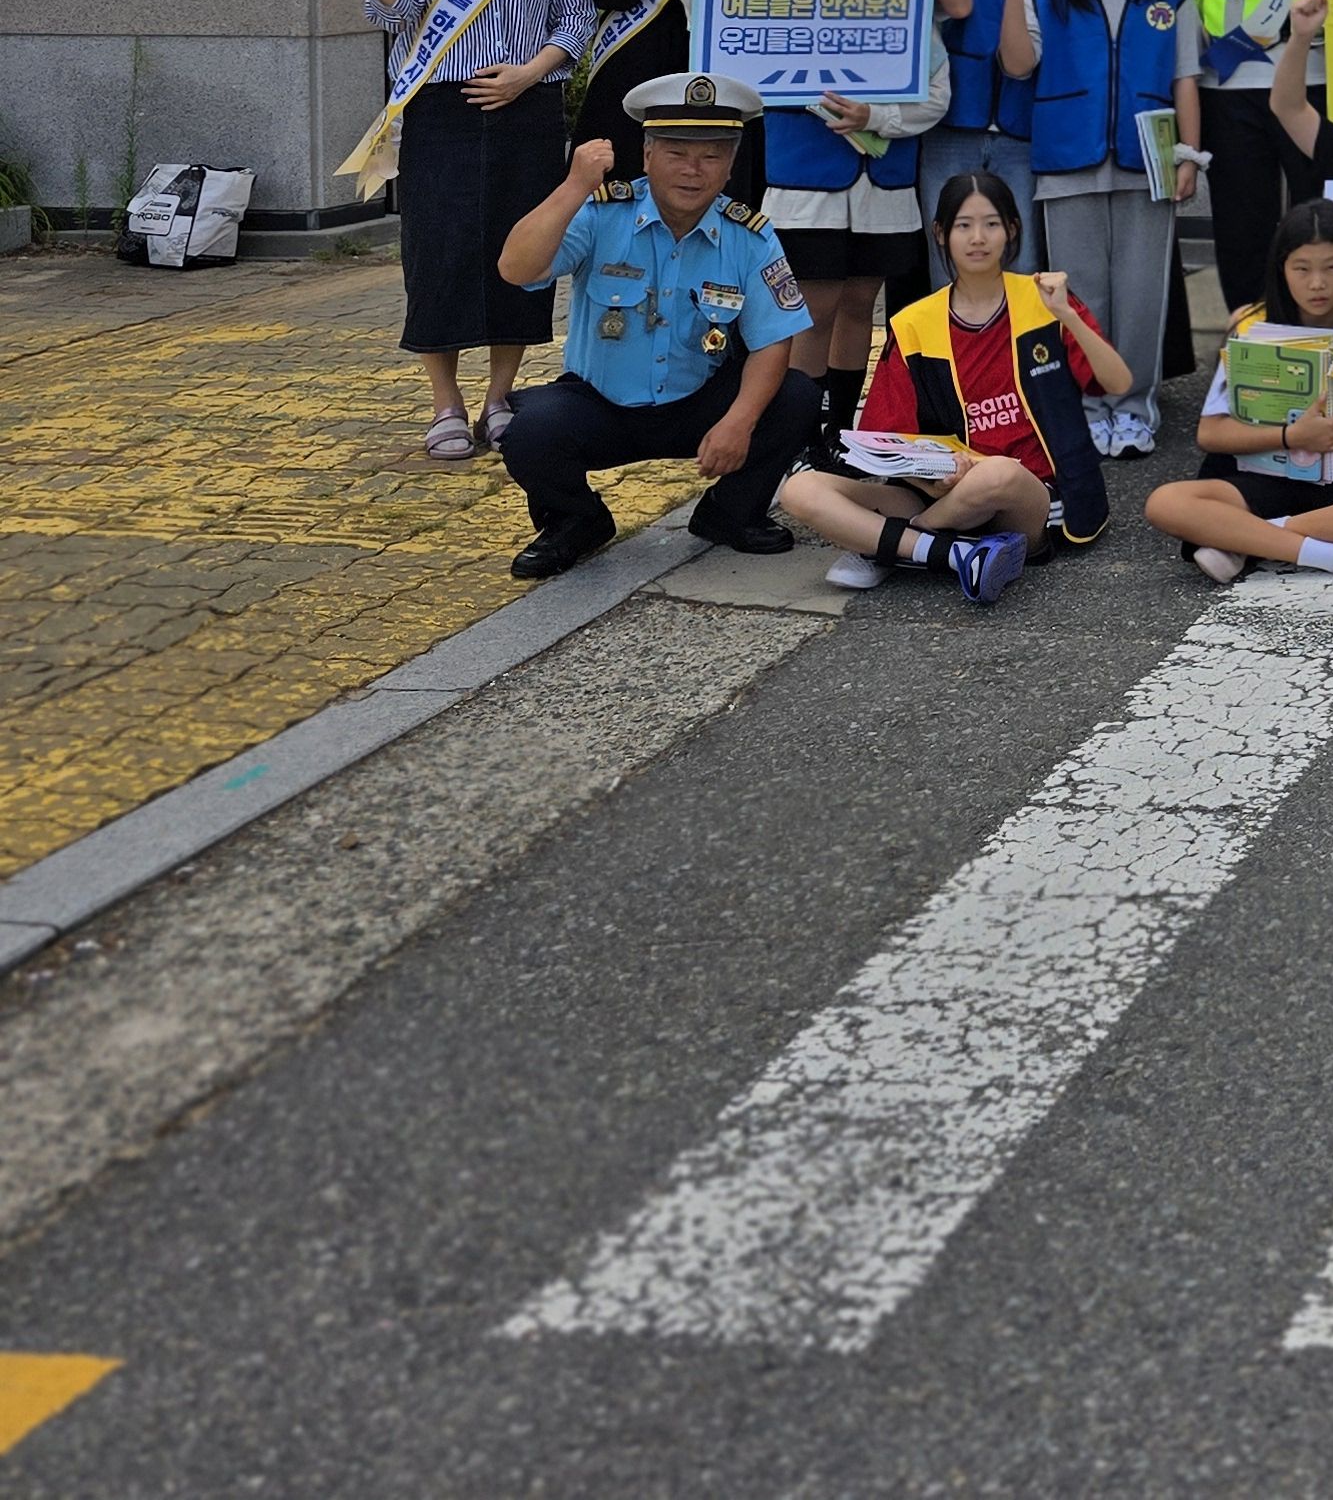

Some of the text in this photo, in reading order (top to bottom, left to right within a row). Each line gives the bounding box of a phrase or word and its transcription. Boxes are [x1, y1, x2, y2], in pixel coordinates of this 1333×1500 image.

[591, 4, 649, 62] 하지맙시
[718, 26, 908, 56] 우리들은 안전보행
[392, 12, 458, 100] 하지맙시다
[964, 391, 1019, 417] eam
[968, 407, 1020, 434] ewer
